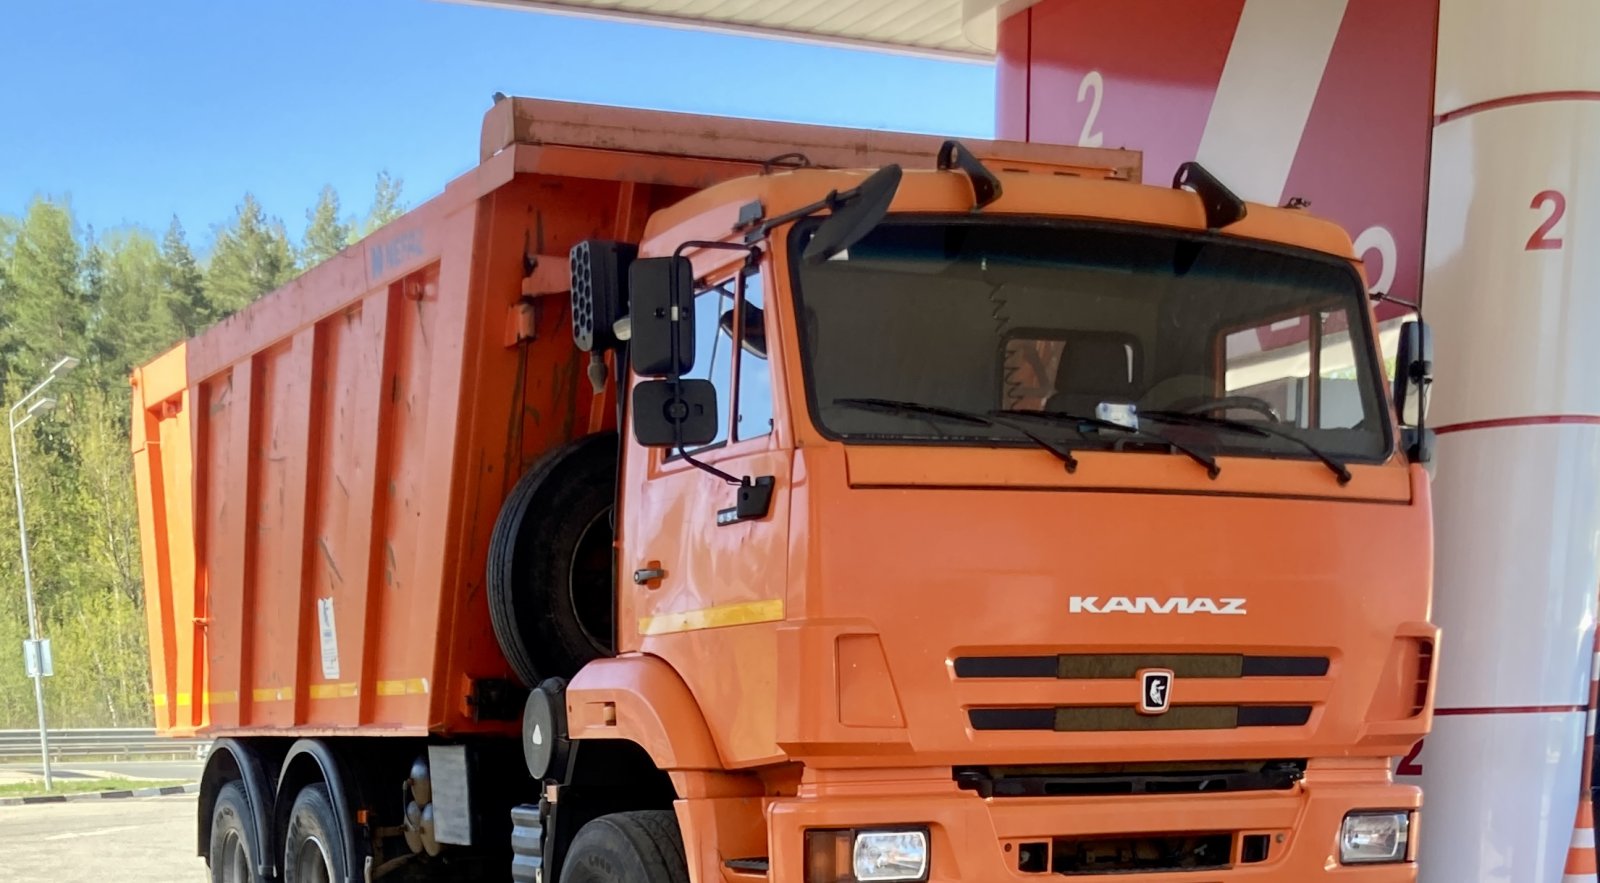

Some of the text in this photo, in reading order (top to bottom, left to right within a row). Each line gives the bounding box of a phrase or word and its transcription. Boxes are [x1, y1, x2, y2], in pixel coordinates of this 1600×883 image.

[1077, 71, 1103, 148] 2
[1525, 190, 1566, 251] 2
[1069, 596, 1247, 615] KAMAZ
